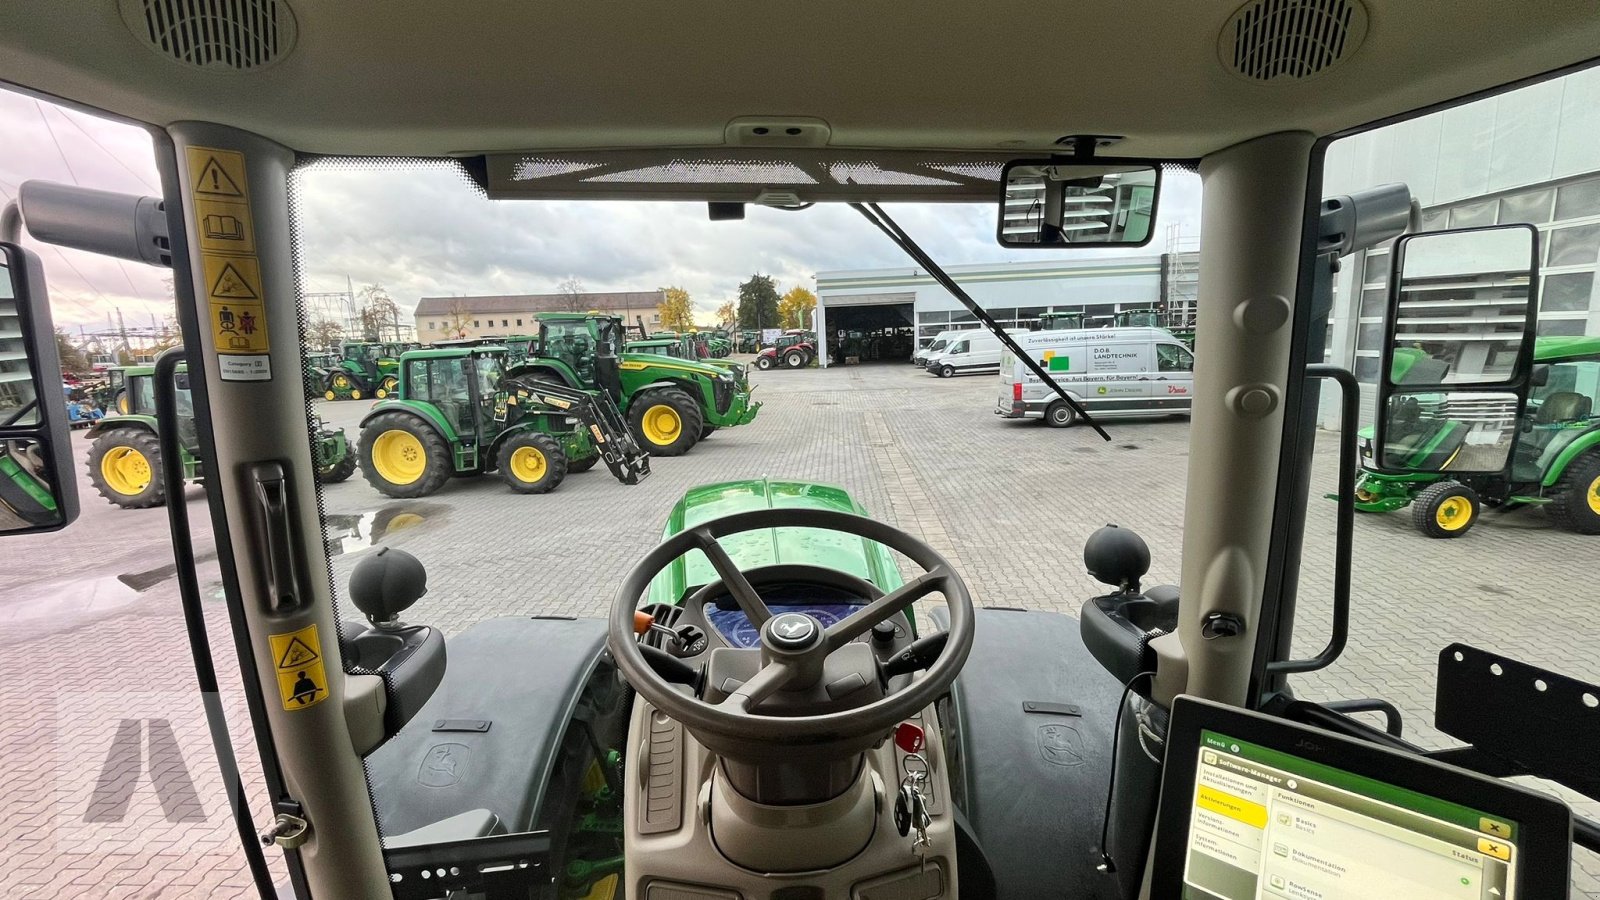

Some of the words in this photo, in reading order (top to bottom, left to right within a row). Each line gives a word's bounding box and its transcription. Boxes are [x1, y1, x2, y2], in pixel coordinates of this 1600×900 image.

[1206, 737, 1226, 748] Menü
[1203, 769, 1244, 787] Installationen
[1244, 783, 1258, 791] und
[1219, 758, 1282, 784] Software-Manager
[1202, 775, 1253, 796] Aktualisierungen
[1200, 793, 1241, 812] Aktivierungen
[1277, 792, 1315, 809] Funktionen
[1295, 816, 1317, 829] Basics
[1295, 823, 1315, 835] Basics
[1292, 848, 1347, 873] Dokumentation
[1452, 849, 1479, 864] Status
[1292, 855, 1341, 878] Dokumentation
[1289, 880, 1323, 898] RowSense
